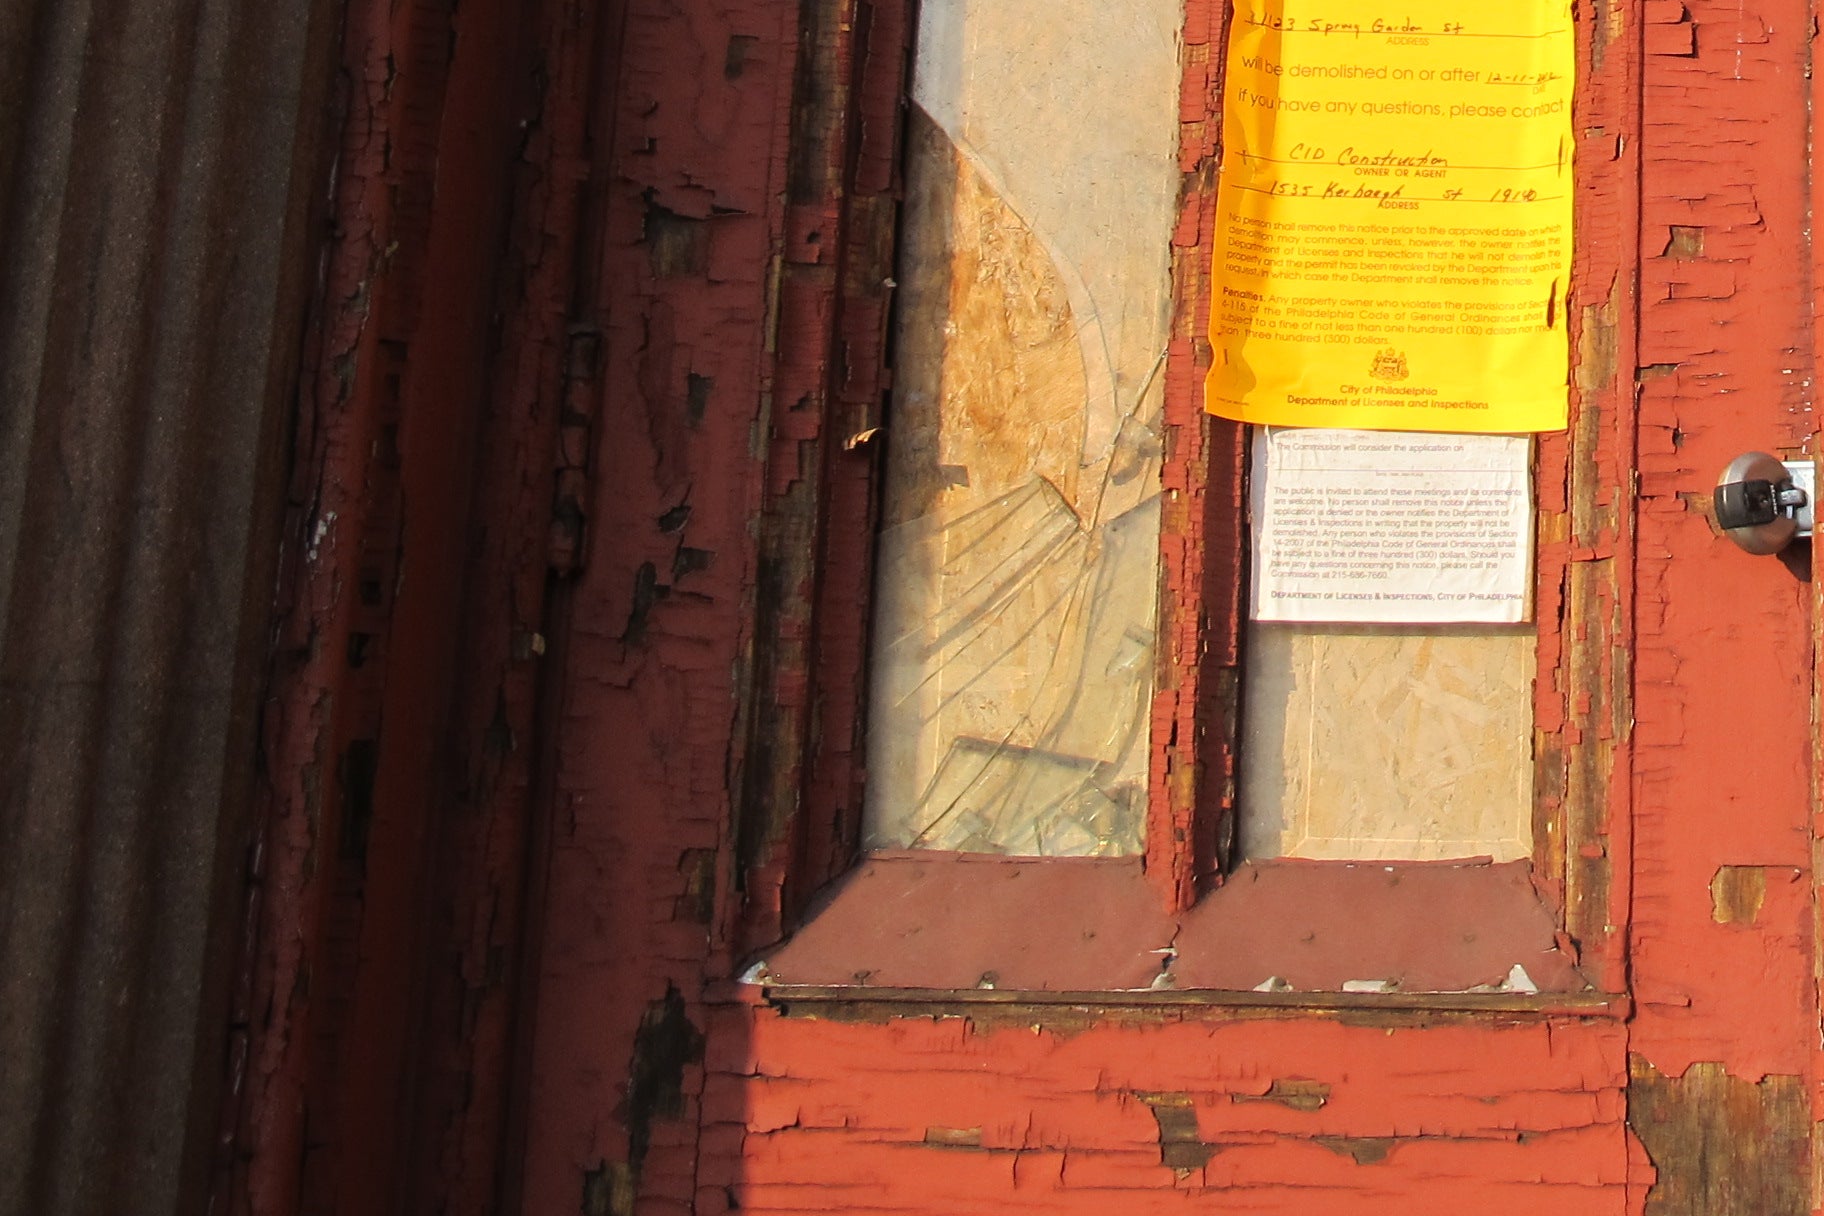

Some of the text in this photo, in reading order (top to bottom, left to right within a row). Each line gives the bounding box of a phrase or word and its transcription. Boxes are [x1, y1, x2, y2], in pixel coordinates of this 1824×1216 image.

[1386, 35, 1430, 46] ADDRESS
[1264, 59, 1283, 76] be
[1288, 64, 1388, 80] demolished
[1391, 68, 1414, 81] on
[1418, 69, 1437, 82] or
[1440, 67, 1480, 82] after
[1250, 93, 1274, 111] you
[1277, 97, 1321, 112] have
[1325, 101, 1357, 116] any
[1361, 101, 1445, 117] questions,
[1450, 103, 1507, 119] please
[1511, 98, 1564, 119] contact
[1354, 167, 1447, 178] OWNER OR AGENT
[1298, 224, 1336, 233] remove
[1338, 223, 1355, 232] this
[1358, 225, 1391, 234] notice
[1391, 225, 1413, 236] prior
[1416, 226, 1427, 234] to
[1429, 225, 1446, 235] the
[1448, 227, 1499, 237] approved
[1501, 227, 1527, 237] date
[1275, 333, 1321, 343] hundred
[1339, 385, 1438, 396] City of Philadelphia
[1287, 394, 1489, 410] Department of Licenses and Inspections
[1292, 443, 1342, 451] Commission
[1358, 444, 1392, 452] consider
[1408, 444, 1452, 453] application
